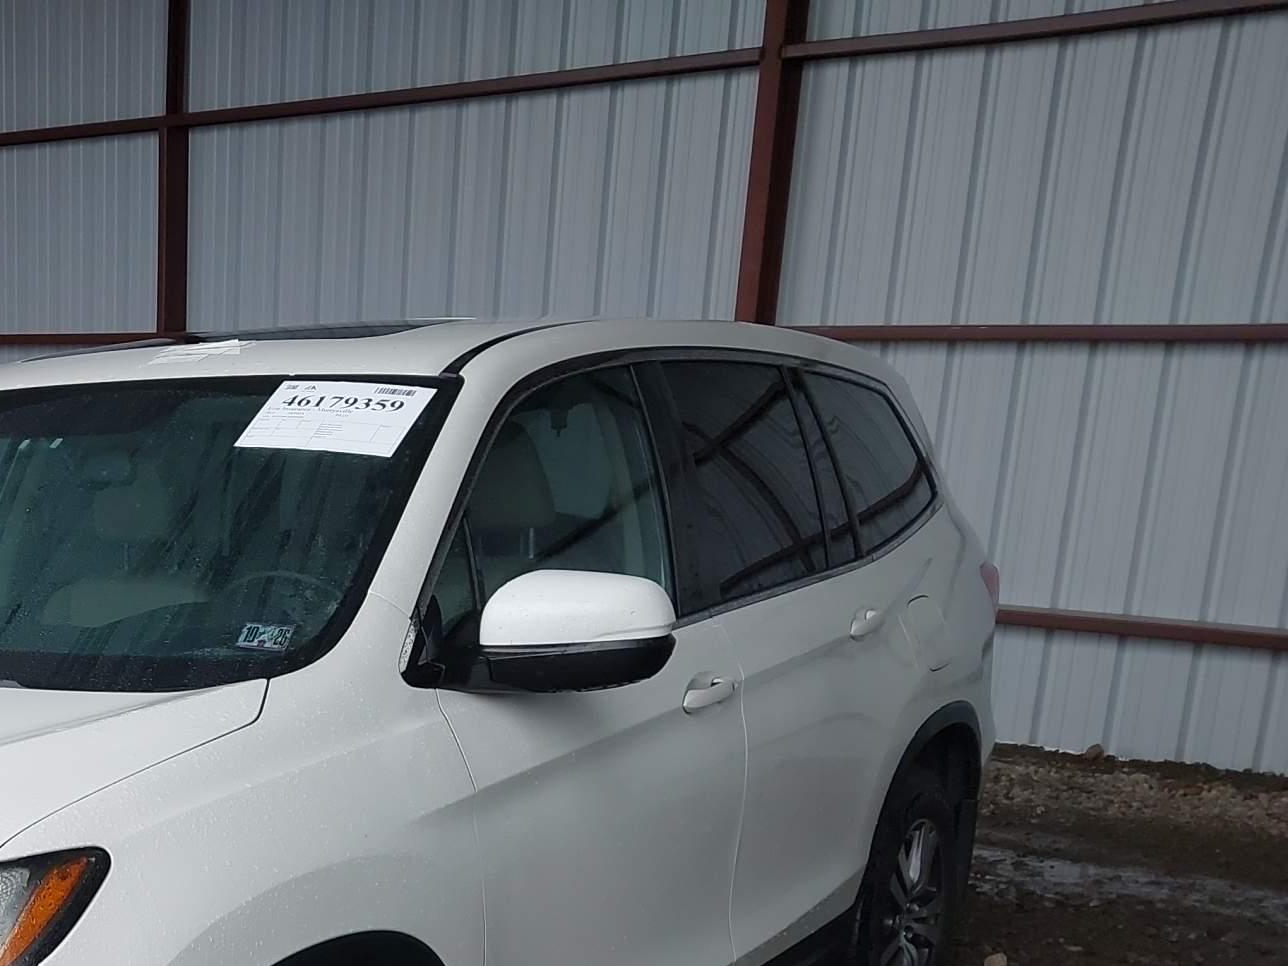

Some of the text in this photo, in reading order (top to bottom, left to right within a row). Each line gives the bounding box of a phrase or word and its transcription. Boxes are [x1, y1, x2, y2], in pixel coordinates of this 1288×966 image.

[282, 394, 405, 413] 46179359
[243, 626, 260, 643] 10
[273, 628, 291, 646] 26
